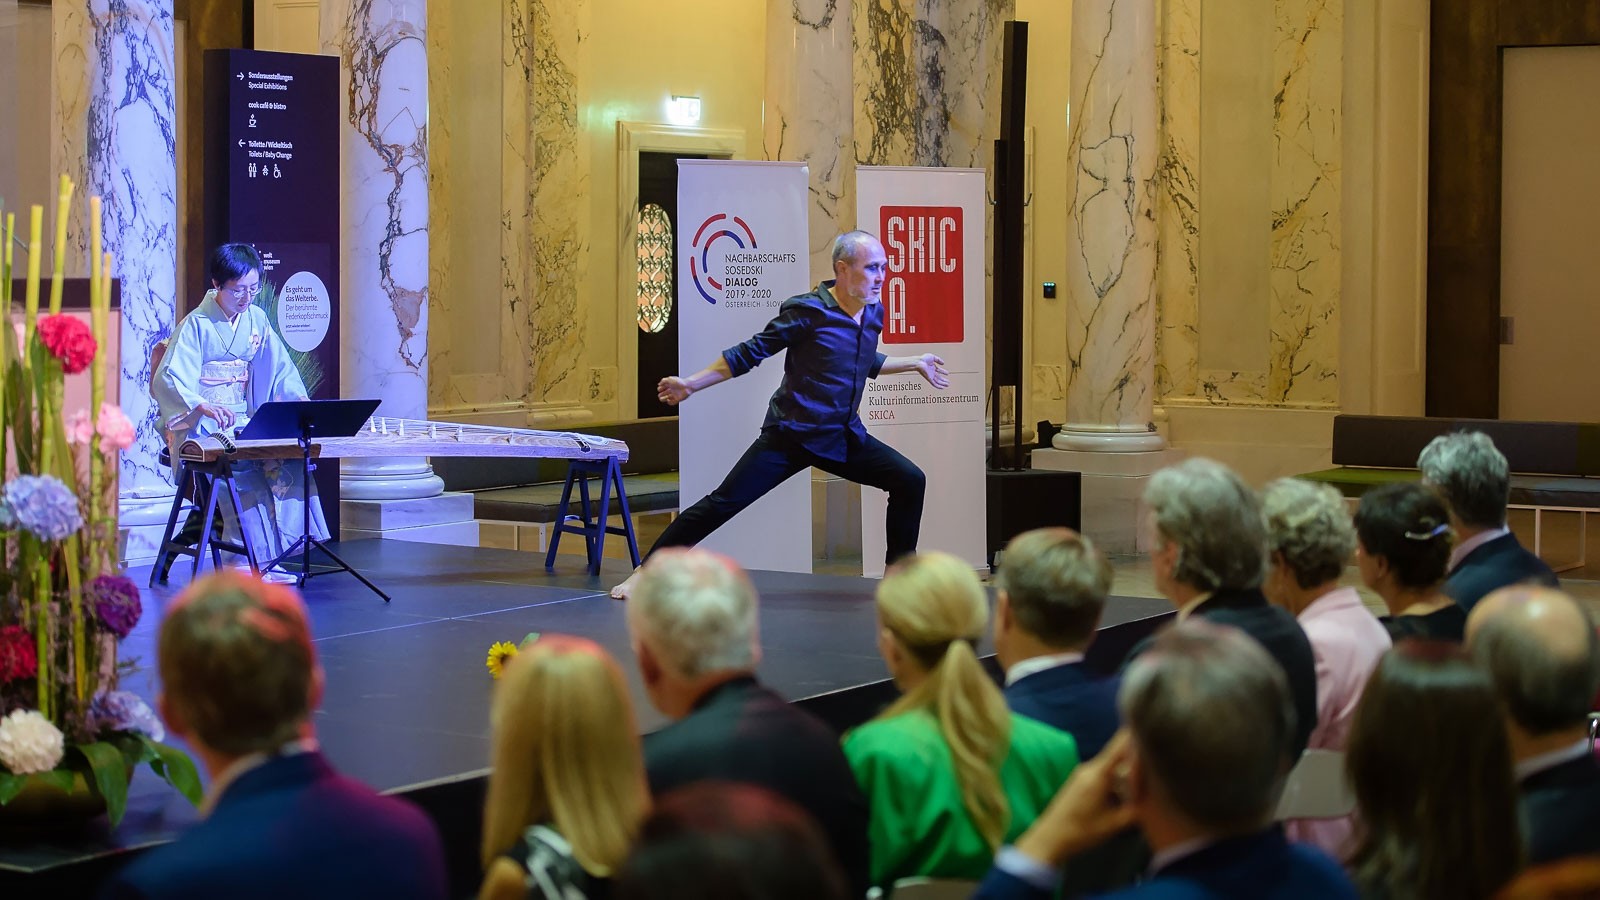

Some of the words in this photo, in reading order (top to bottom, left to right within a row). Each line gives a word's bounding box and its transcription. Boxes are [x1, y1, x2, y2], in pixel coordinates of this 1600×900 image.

[248, 71, 293, 82] Sonderausstellungen
[248, 81, 264, 90] Special
[264, 82, 288, 91] Exhibitions
[273, 102, 287, 110] bistro
[248, 140, 266, 148] Toilette
[268, 141, 293, 149] Wickeltisch
[248, 150, 263, 158] Toilets
[265, 150, 276, 160] Baby
[275, 151, 293, 161] Change
[887, 215, 957, 274] SKIC
[725, 253, 796, 263] NACHBARSCHAFTS
[725, 265, 763, 275] SOSEDSKI
[725, 277, 758, 287] DIALOG
[285, 285, 292, 293] Es
[291, 285, 304, 295] geht
[725, 289, 746, 299] 2019
[751, 289, 772, 299] 2020
[285, 294, 295, 302] das
[294, 294, 319, 302] Welterbe.
[285, 304, 295, 312] Der
[294, 303, 318, 311] berühmte
[888, 276, 916, 334] A.
[285, 312, 329, 321] Federkopfschmuck
[868, 381, 922, 393] Slowenisches
[868, 394, 980, 406] Kulturinformationszentrum
[868, 409, 896, 420] SKICA
